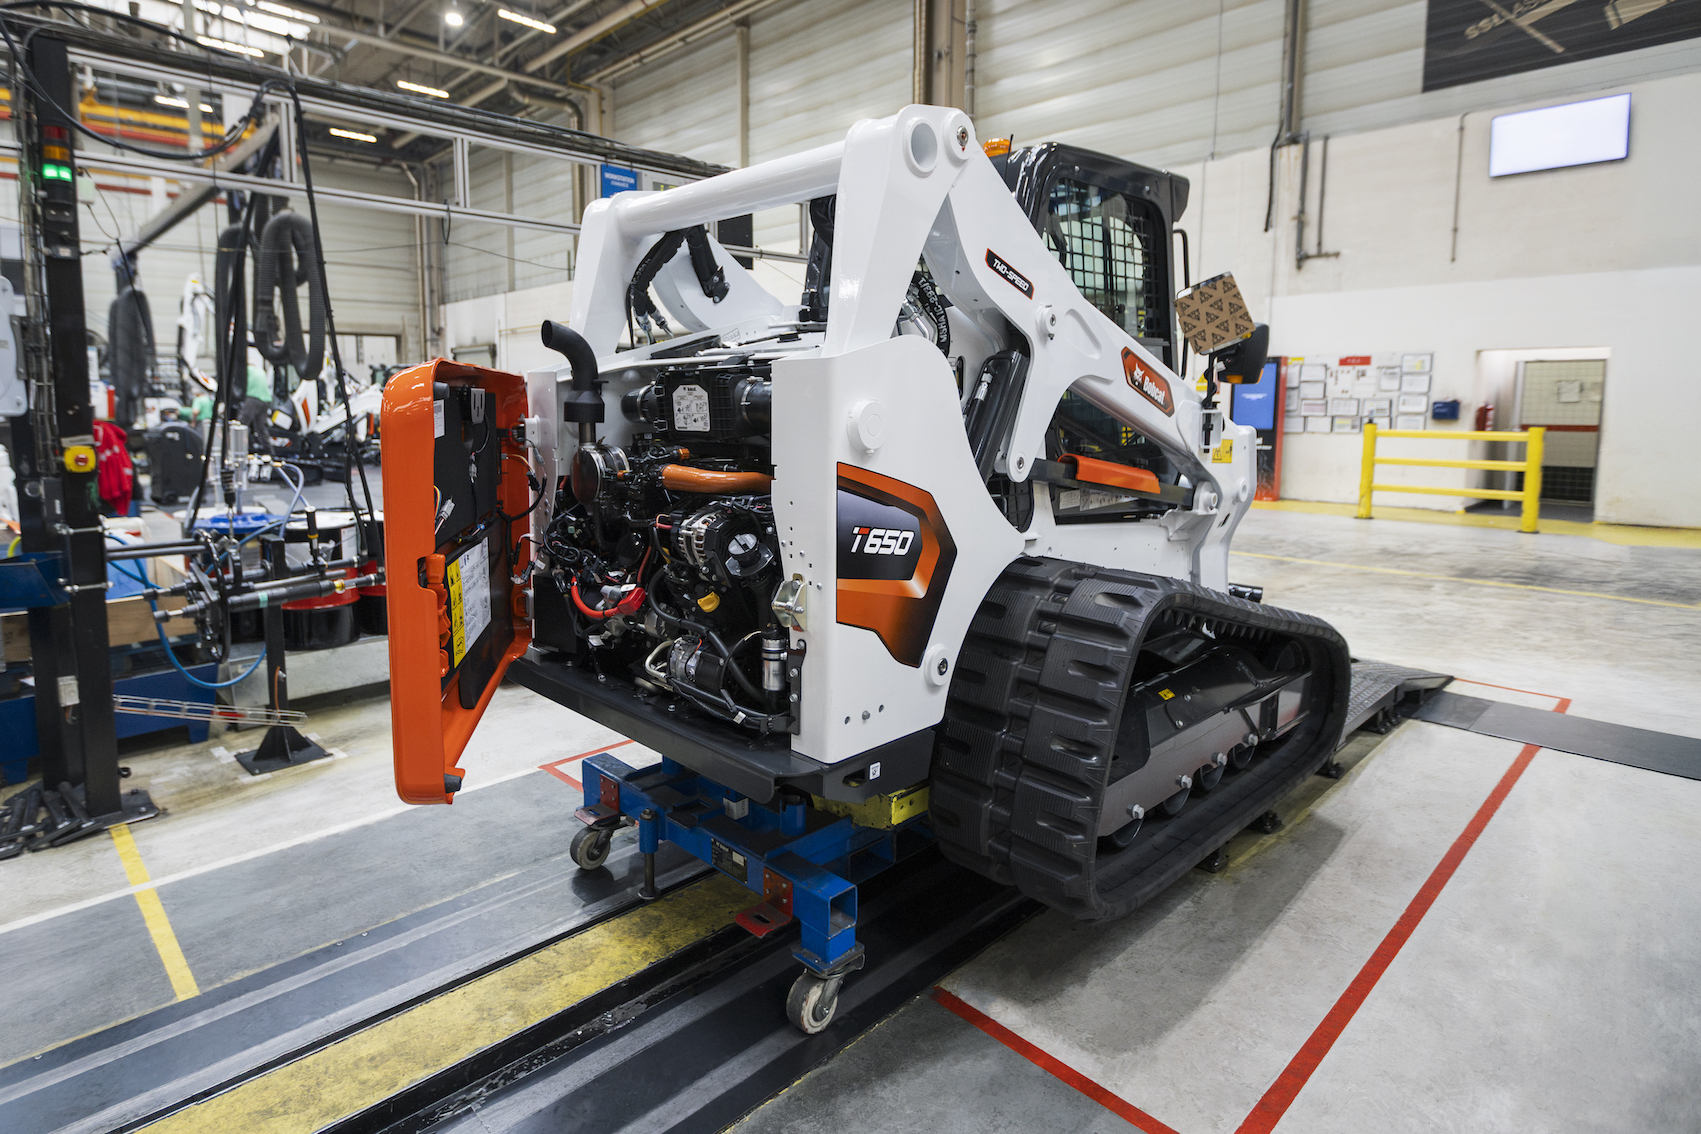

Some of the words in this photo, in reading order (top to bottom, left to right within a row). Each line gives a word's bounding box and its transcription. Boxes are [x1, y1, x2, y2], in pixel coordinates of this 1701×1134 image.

[993, 259, 1029, 291] TWO-SPEED
[1143, 375, 1166, 405] Bobcat
[850, 526, 915, 555] T650
